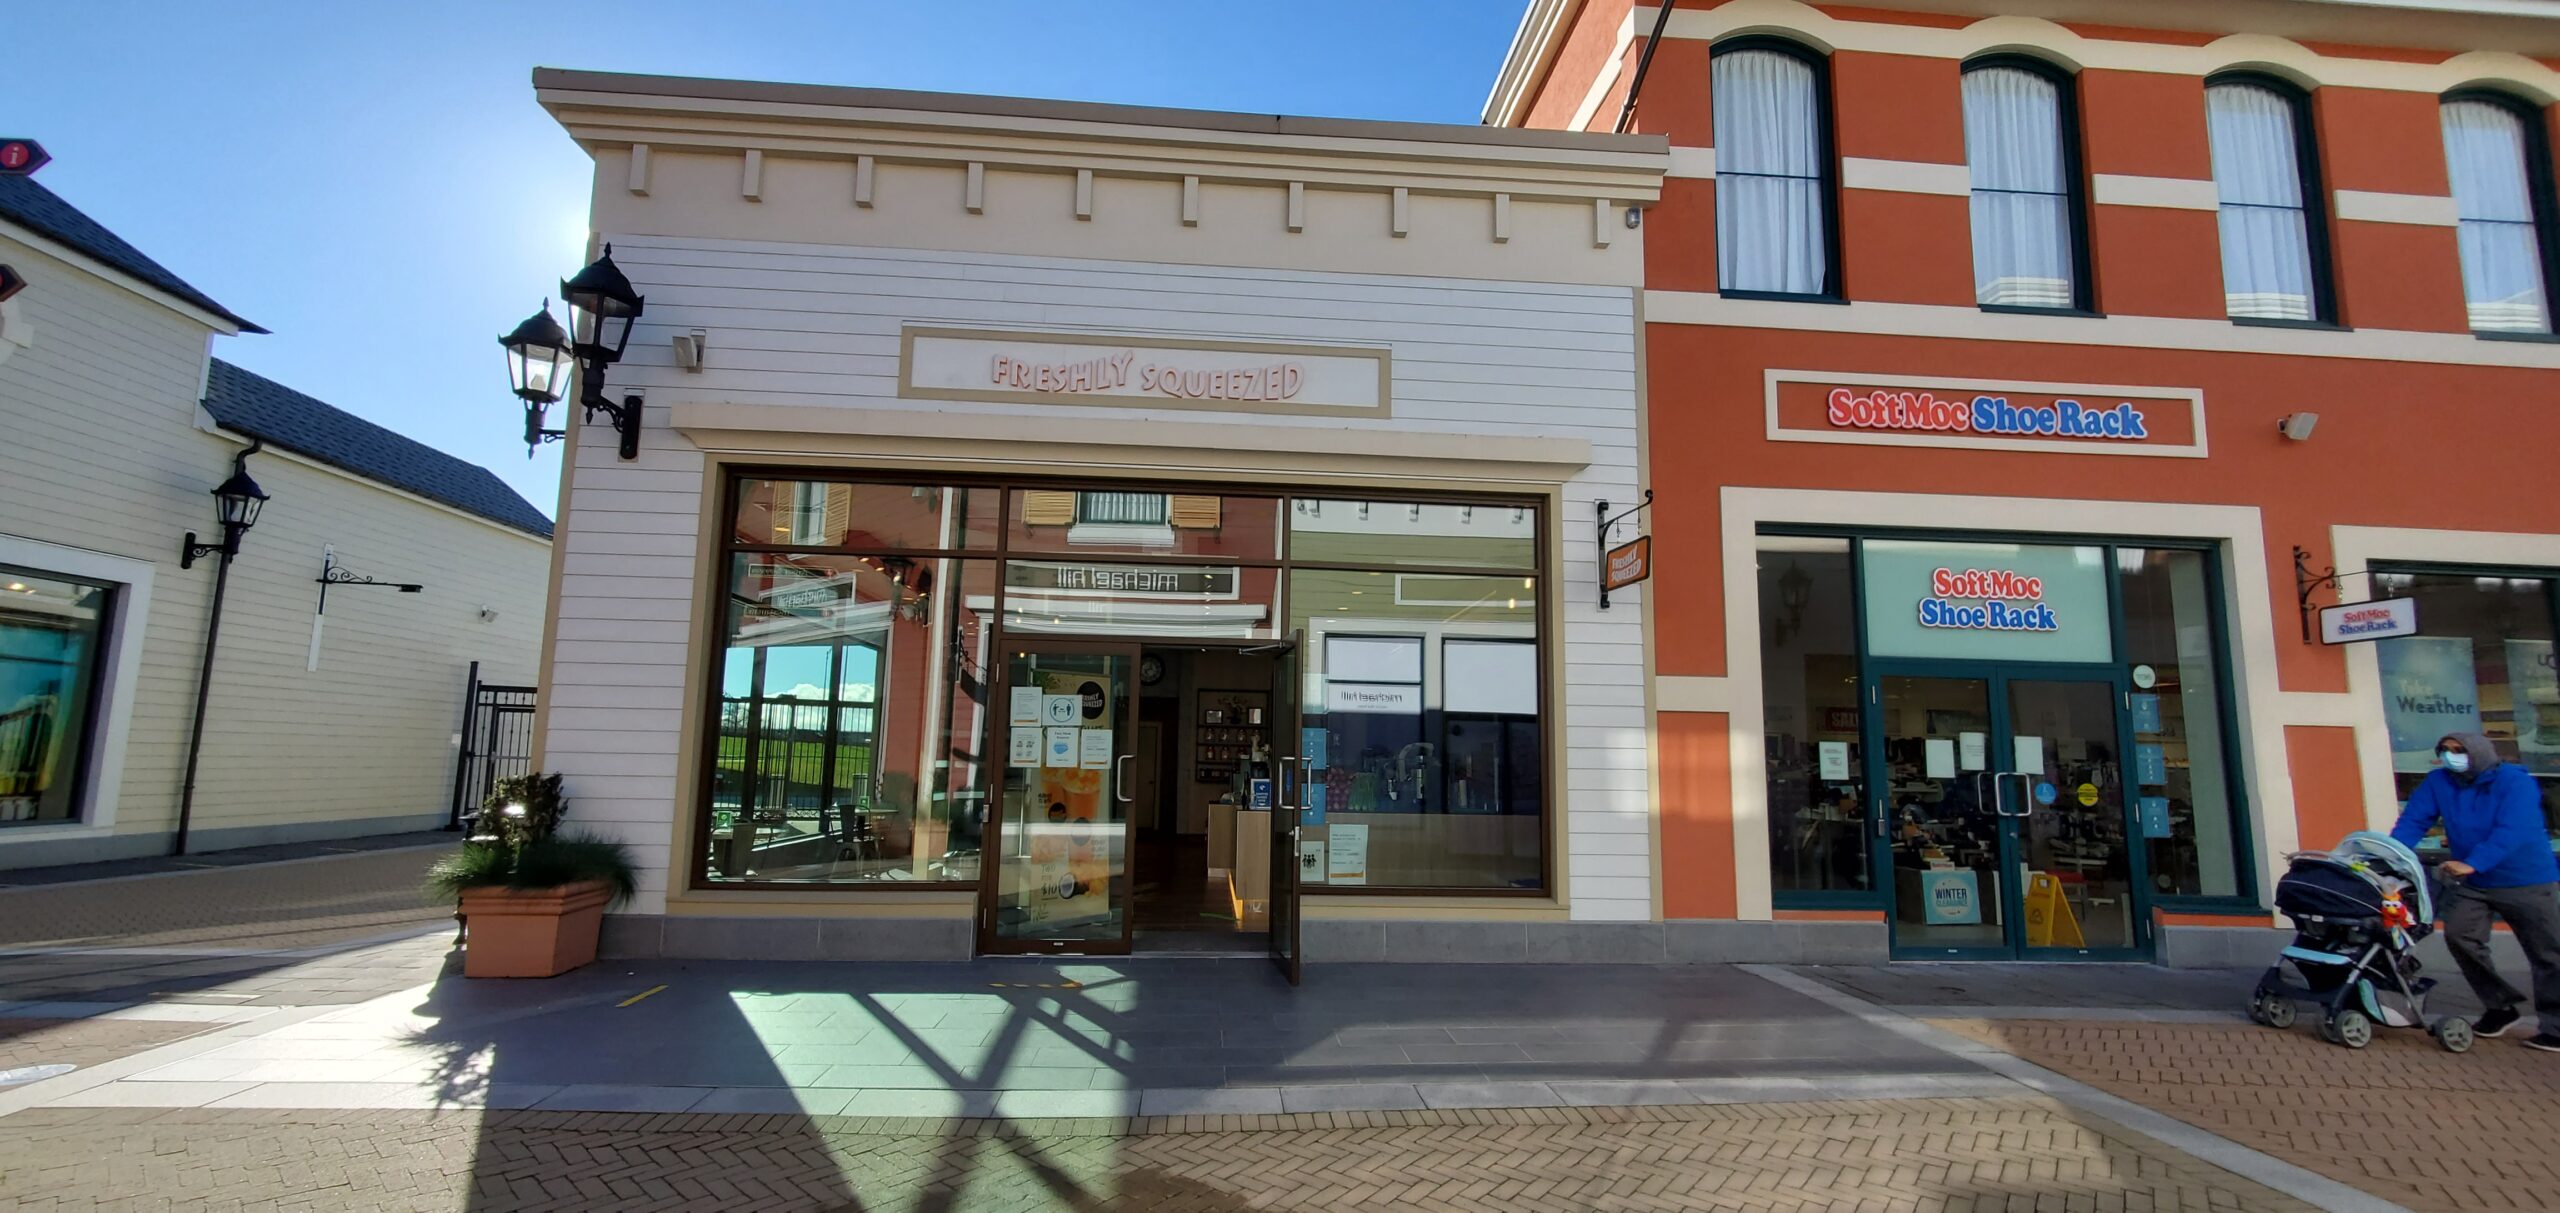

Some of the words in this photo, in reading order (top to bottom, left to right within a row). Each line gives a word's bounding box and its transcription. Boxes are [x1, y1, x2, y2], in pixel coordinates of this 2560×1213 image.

[991, 349, 1135, 393] FRESHLY
[1140, 362, 1305, 401] SQUEEZED
[1828, 388, 1970, 431] SoftMoc
[1970, 396, 2055, 434] Shoe
[2055, 399, 2148, 439] Rack
[1932, 566, 2042, 600] SoftMoc
[1919, 597, 1988, 629] Shoe
[1987, 601, 2059, 632] Rack
[1832, 711, 1858, 728] SAL
[2396, 695, 2473, 714] Weather
[1935, 888, 1967, 899] WINTER
